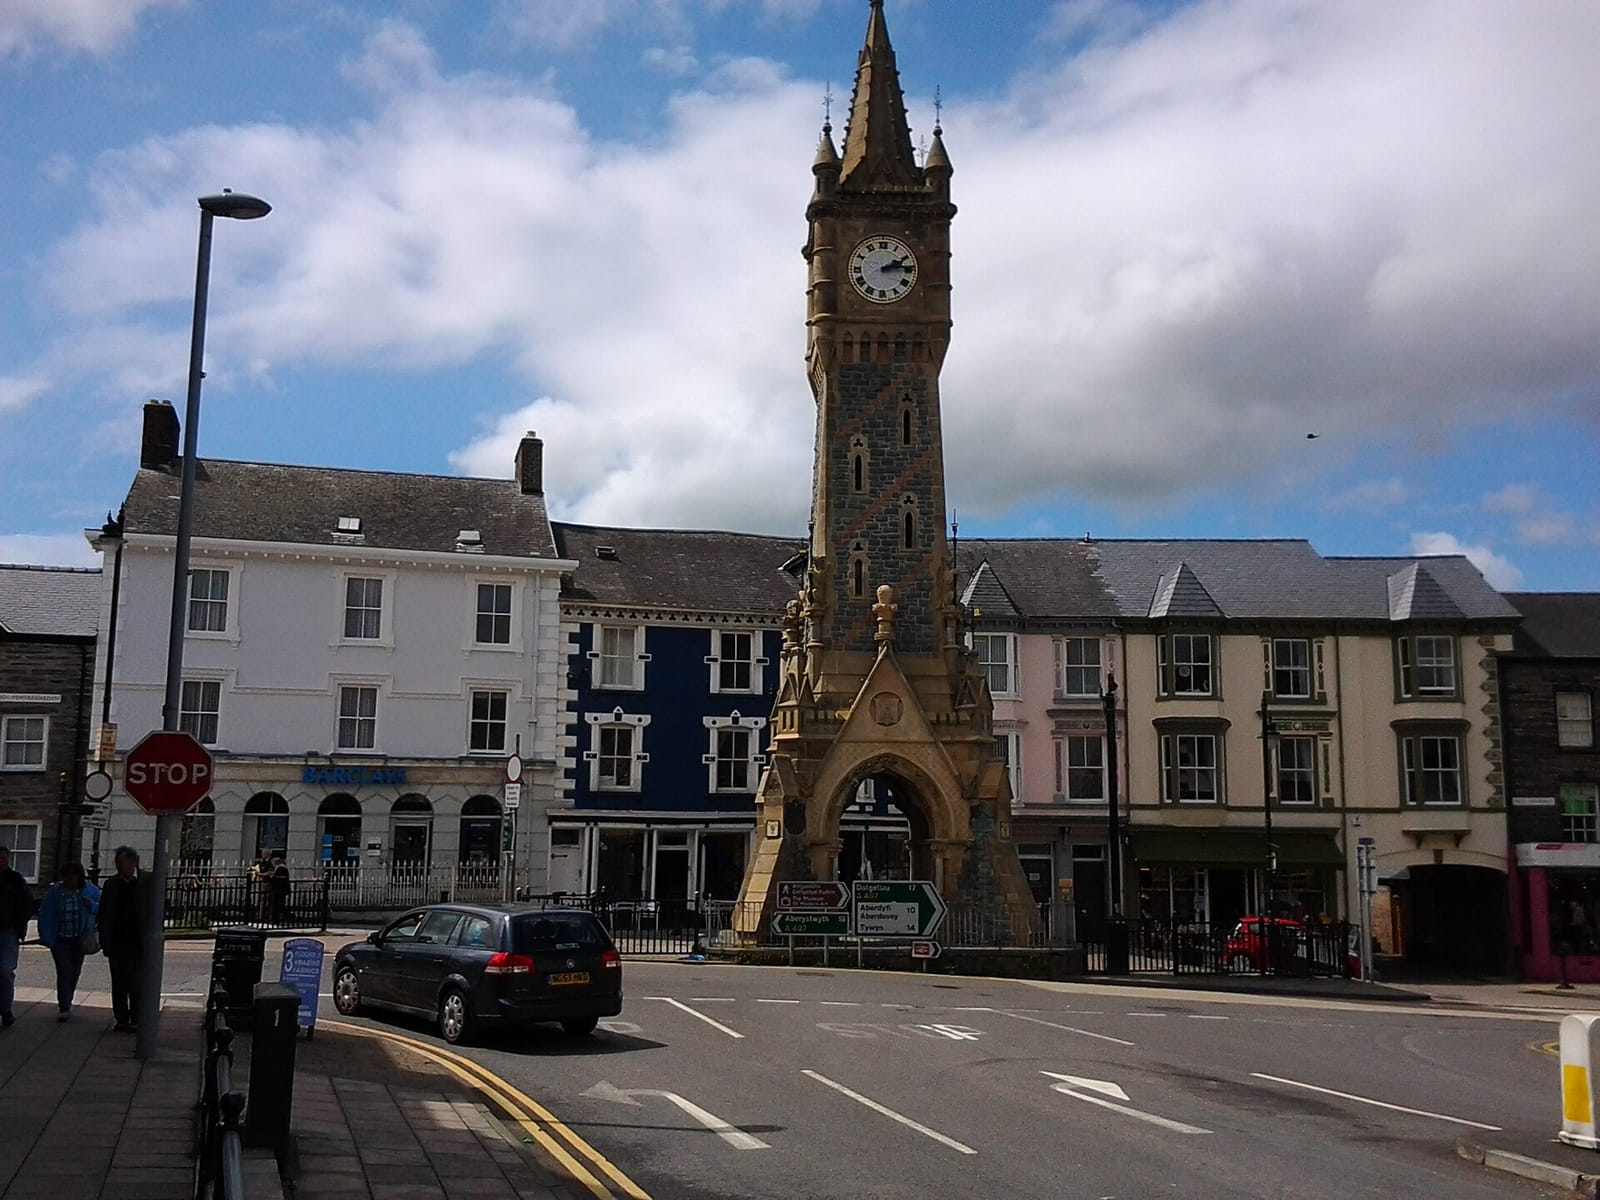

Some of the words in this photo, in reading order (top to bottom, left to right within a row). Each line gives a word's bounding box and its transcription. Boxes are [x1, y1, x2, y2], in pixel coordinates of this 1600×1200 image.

[128, 762, 208, 784] STOP
[304, 766, 407, 784] BARCLAYS
[784, 915, 830, 924] Aberystwyth
[284, 950, 293, 972] 3
